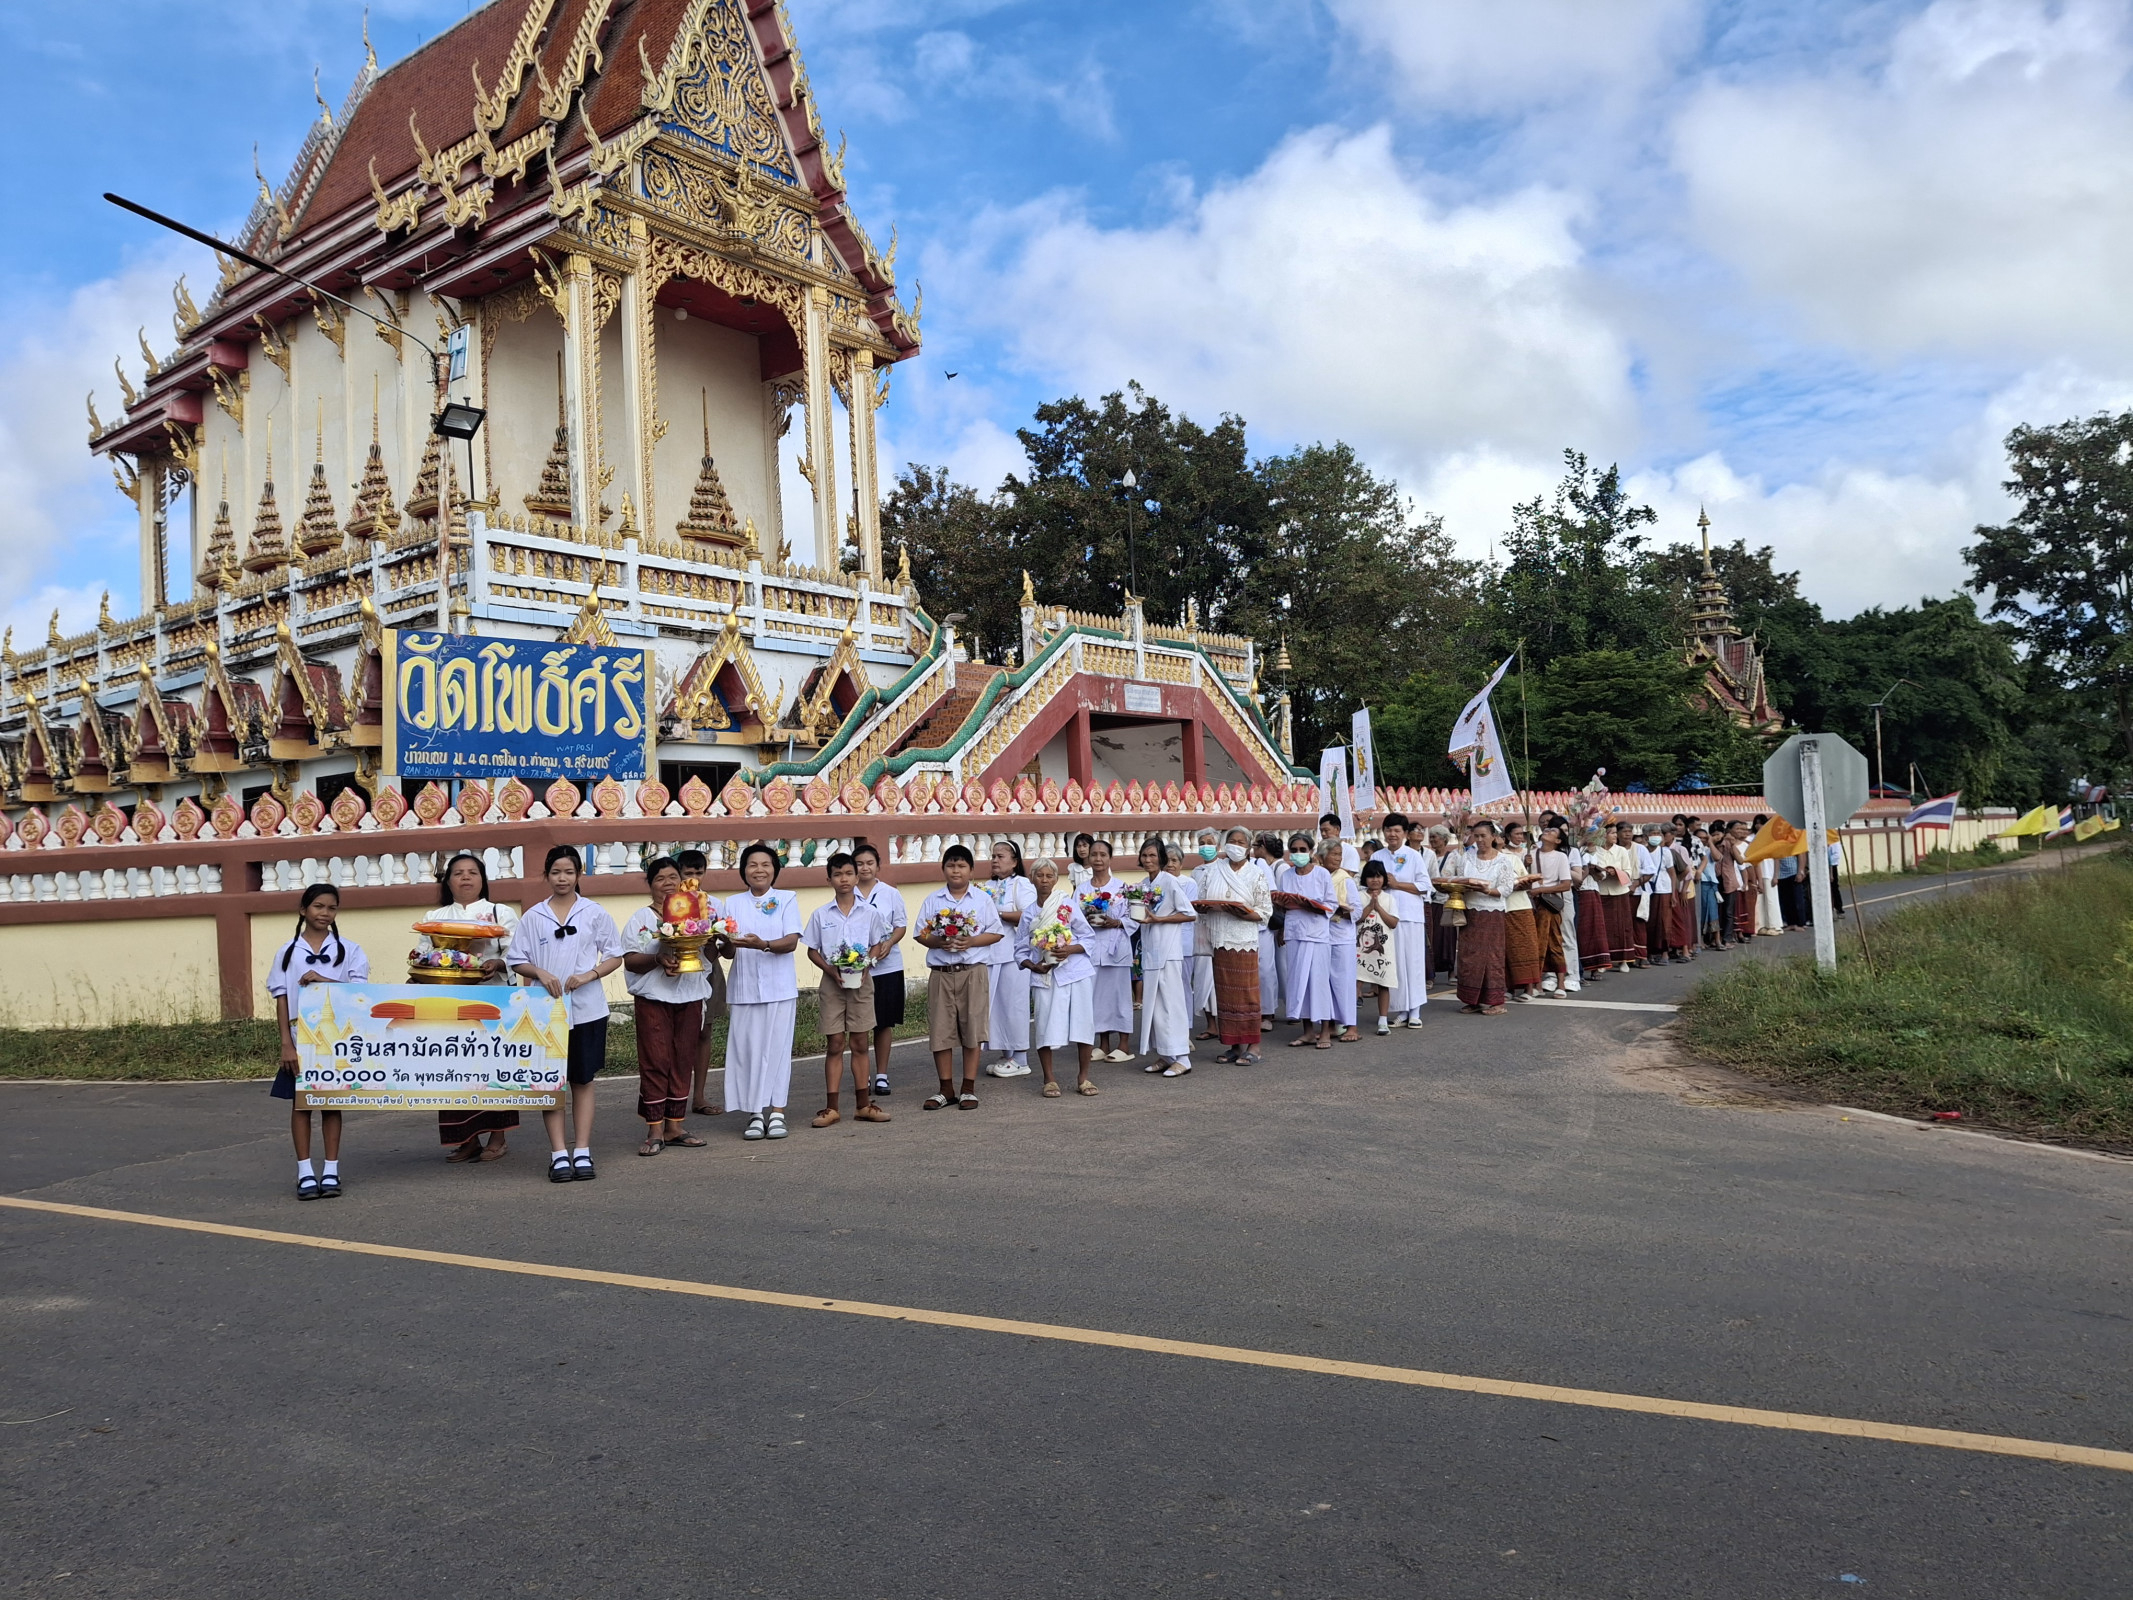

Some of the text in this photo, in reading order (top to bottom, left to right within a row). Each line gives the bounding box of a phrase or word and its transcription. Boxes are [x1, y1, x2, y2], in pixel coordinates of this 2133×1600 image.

[398, 633, 643, 740] วัดโพธิ์ศรี
[556, 743, 594, 754] WAT POSI
[334, 1031, 533, 1063] กฐินสามัคคีทั่วไทย
[305, 1068, 560, 1087] ๓๐,๐๐๐ วัด พุทธศักราช ๒๕๖๘
[307, 1094, 325, 1105] โดย
[471, 1095, 478, 1105] ปี
